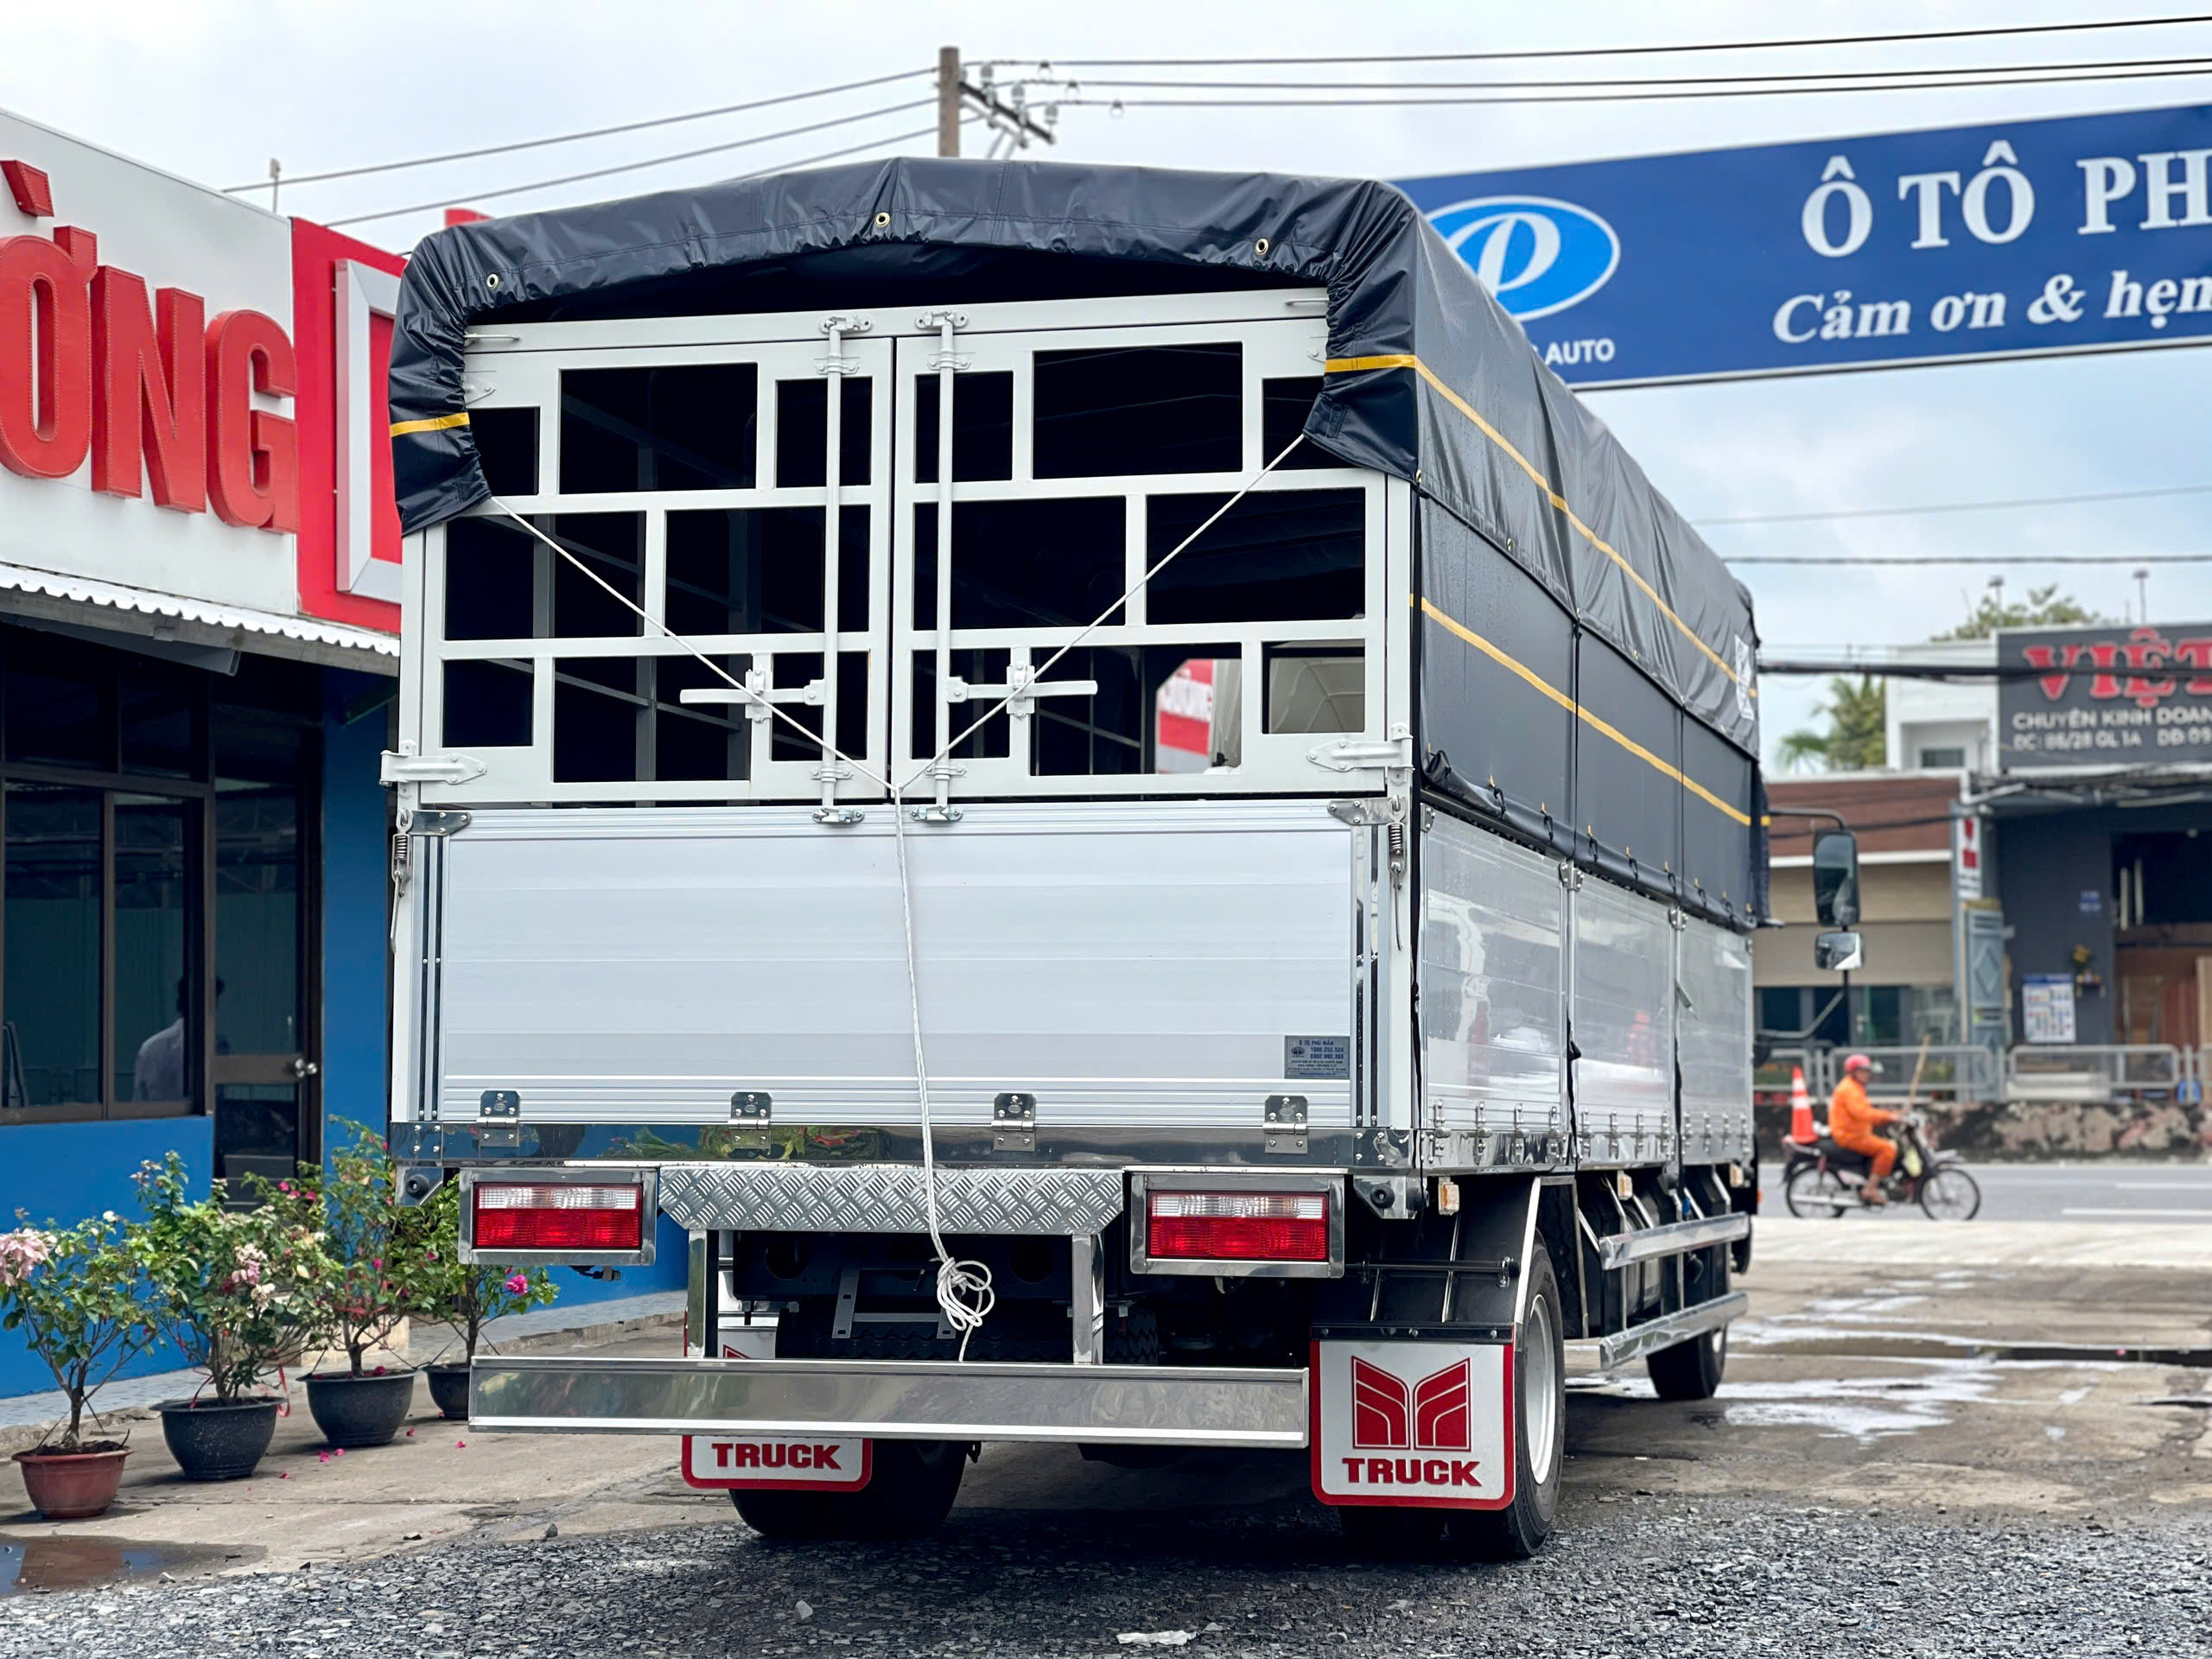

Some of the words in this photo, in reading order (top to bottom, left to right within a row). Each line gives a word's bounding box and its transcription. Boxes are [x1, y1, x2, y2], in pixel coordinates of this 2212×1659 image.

[1801, 155, 1873, 257] Ô
[1897, 139, 2036, 249] TÔ
[2075, 149, 2212, 236] PH
[1772, 289, 1911, 344] Cảm
[1929, 291, 2006, 333] ơn
[2026, 273, 2086, 325] &
[2103, 270, 2212, 330] hẹn
[0, 159, 298, 535] ỜNG
[1545, 338, 1616, 365] AUTO
[711, 1443, 842, 1470] TRUCK
[1342, 1458, 1483, 1487] TRUCK
